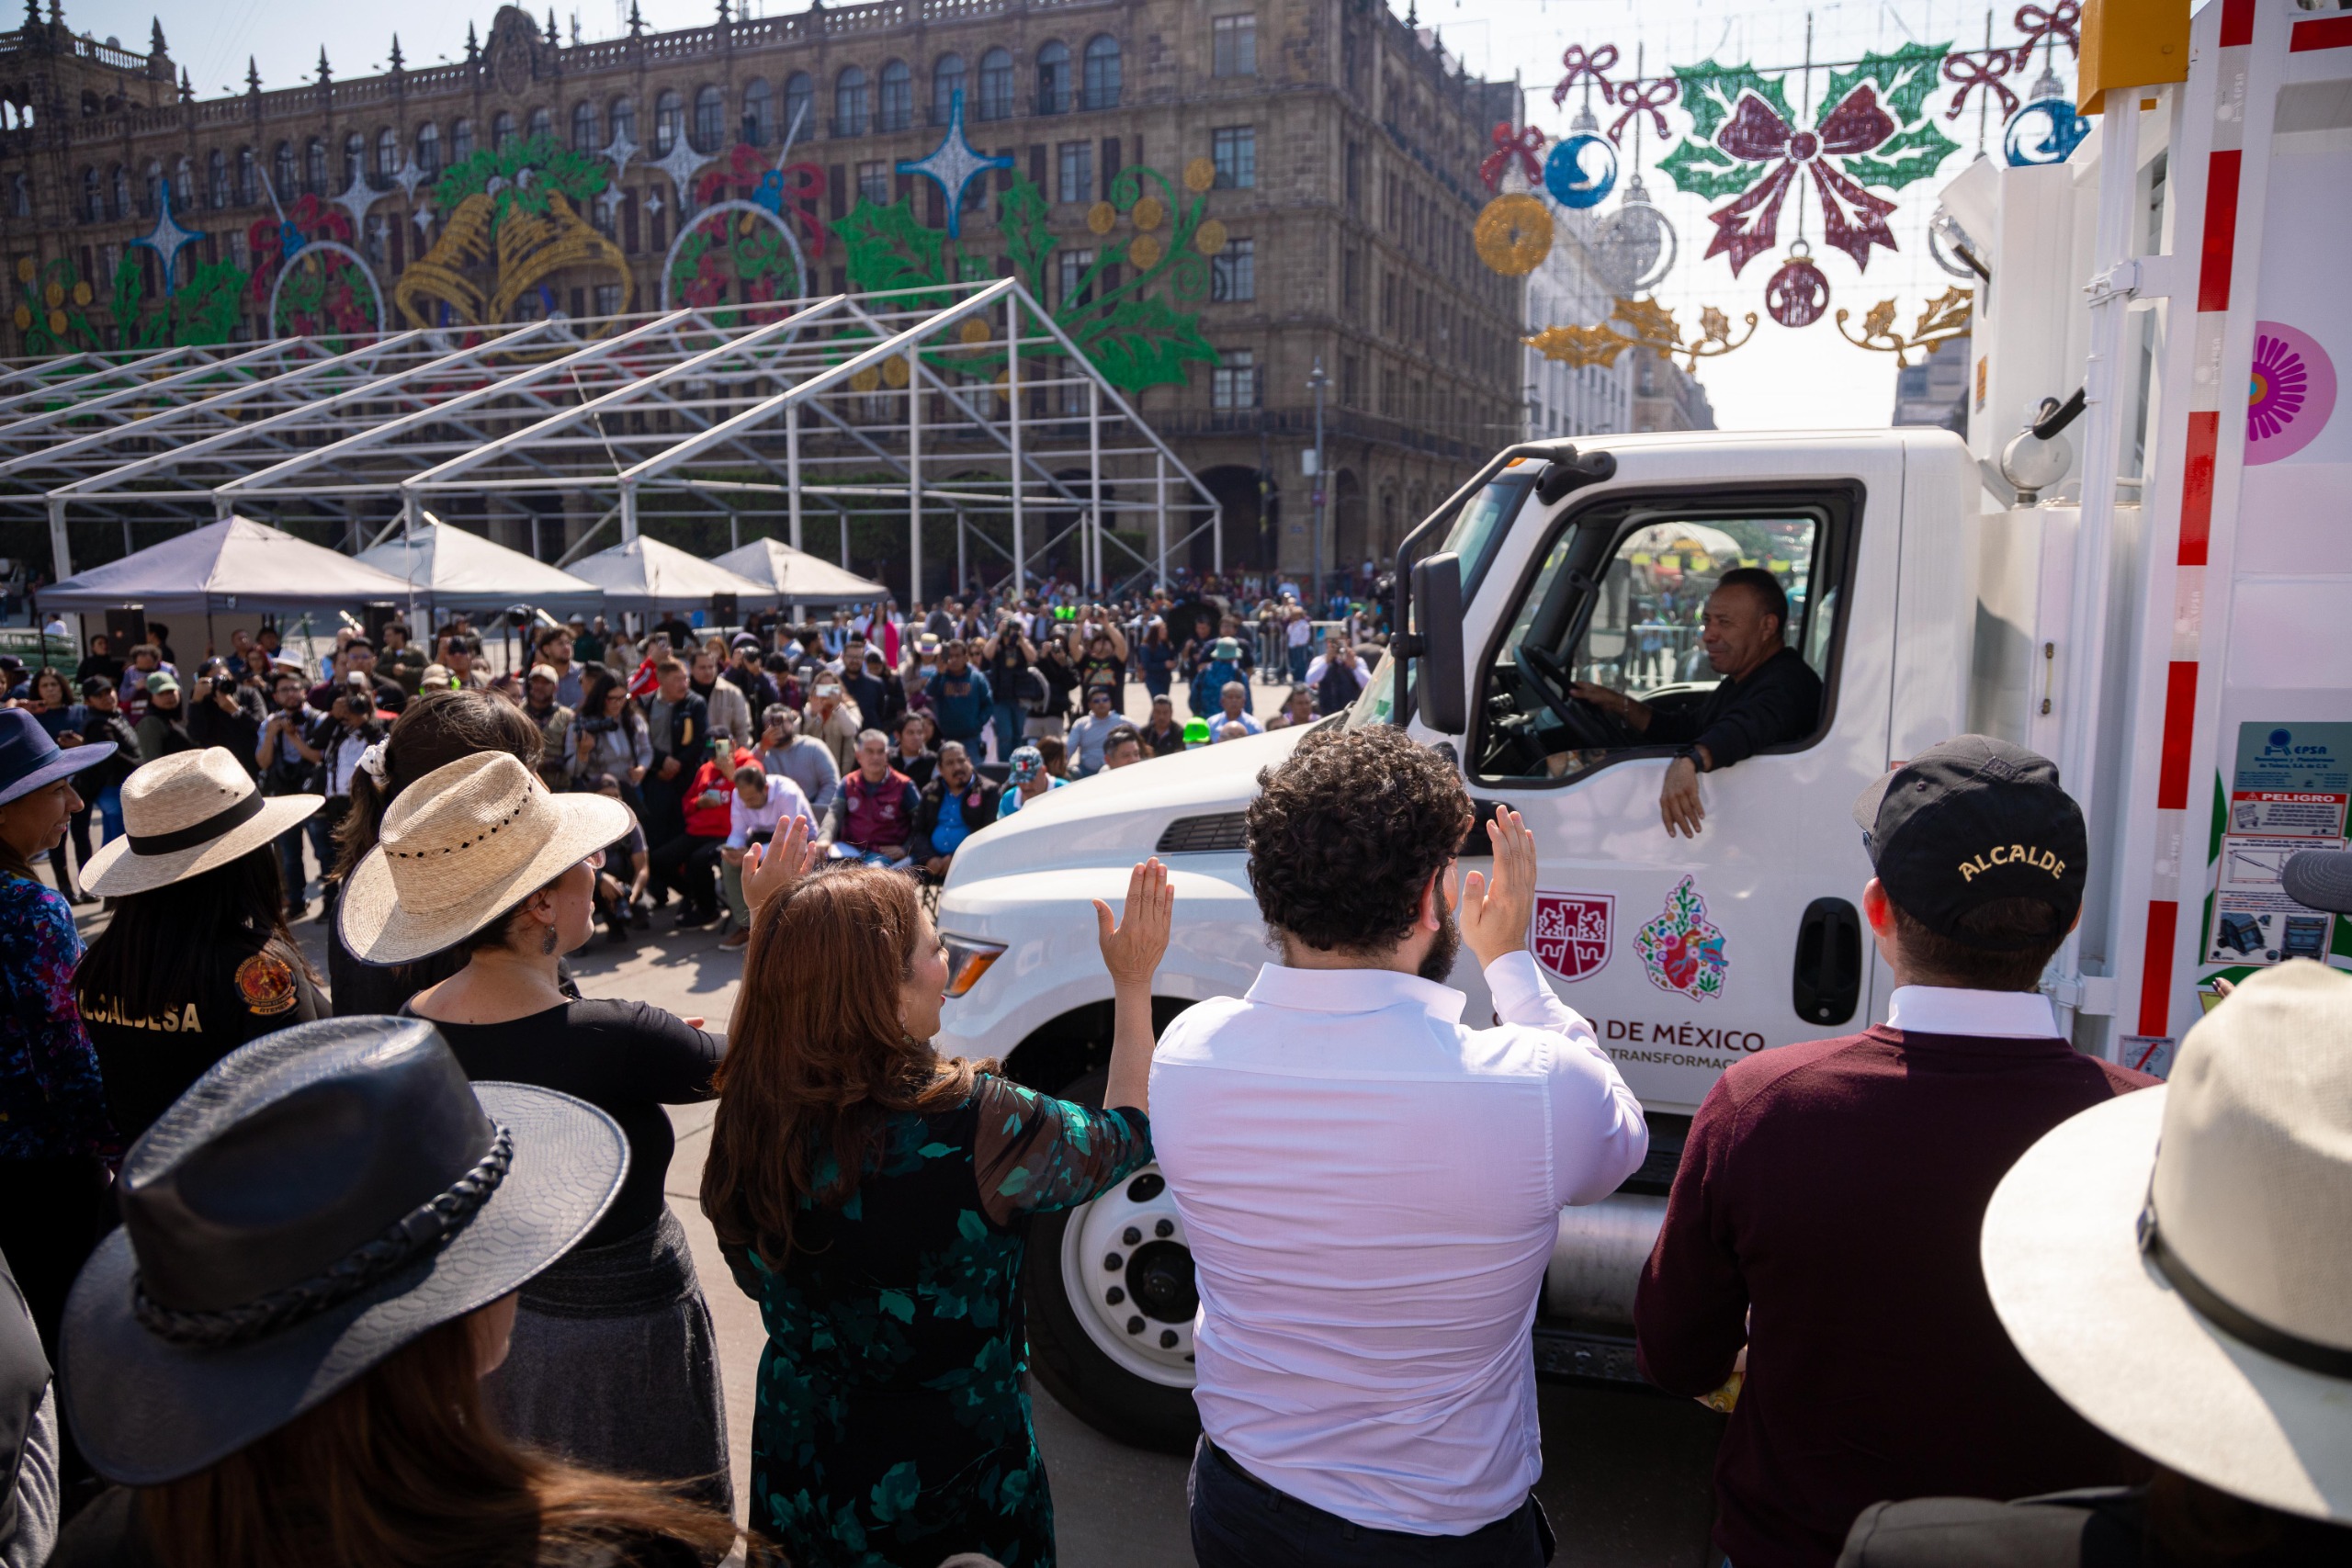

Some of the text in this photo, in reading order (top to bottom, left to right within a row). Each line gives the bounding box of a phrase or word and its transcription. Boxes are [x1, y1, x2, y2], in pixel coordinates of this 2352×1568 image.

[2261, 793, 2335, 802] PELIGRO
[1958, 844, 2066, 883] ALCALDE
[1607, 1020, 1645, 1042] DE
[1652, 1021, 1766, 1053] MÉXICO
[1609, 1048, 1738, 1069] TRANSFORMAC
